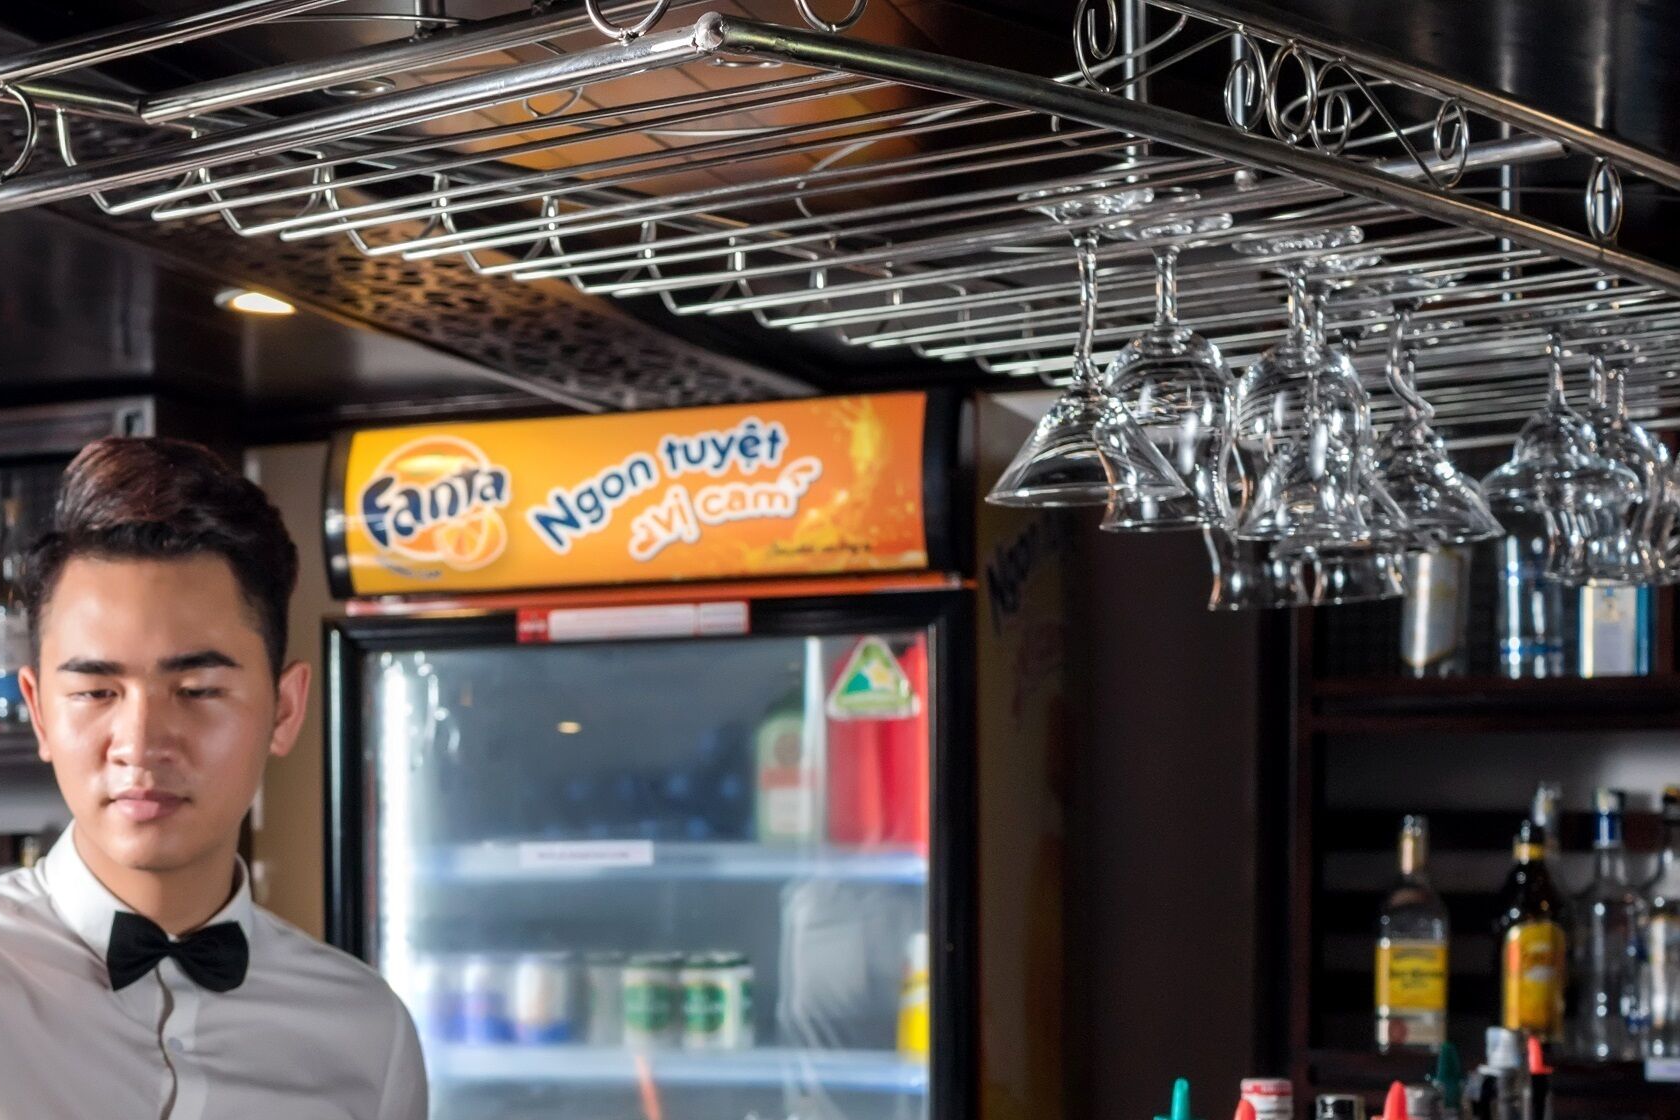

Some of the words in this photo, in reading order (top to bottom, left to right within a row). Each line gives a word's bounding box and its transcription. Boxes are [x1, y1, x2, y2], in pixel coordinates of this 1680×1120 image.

[360, 466, 508, 549] Fanta
[534, 458, 654, 547] Ngon
[664, 423, 782, 473] tuyệt
[699, 487, 793, 519] cam
